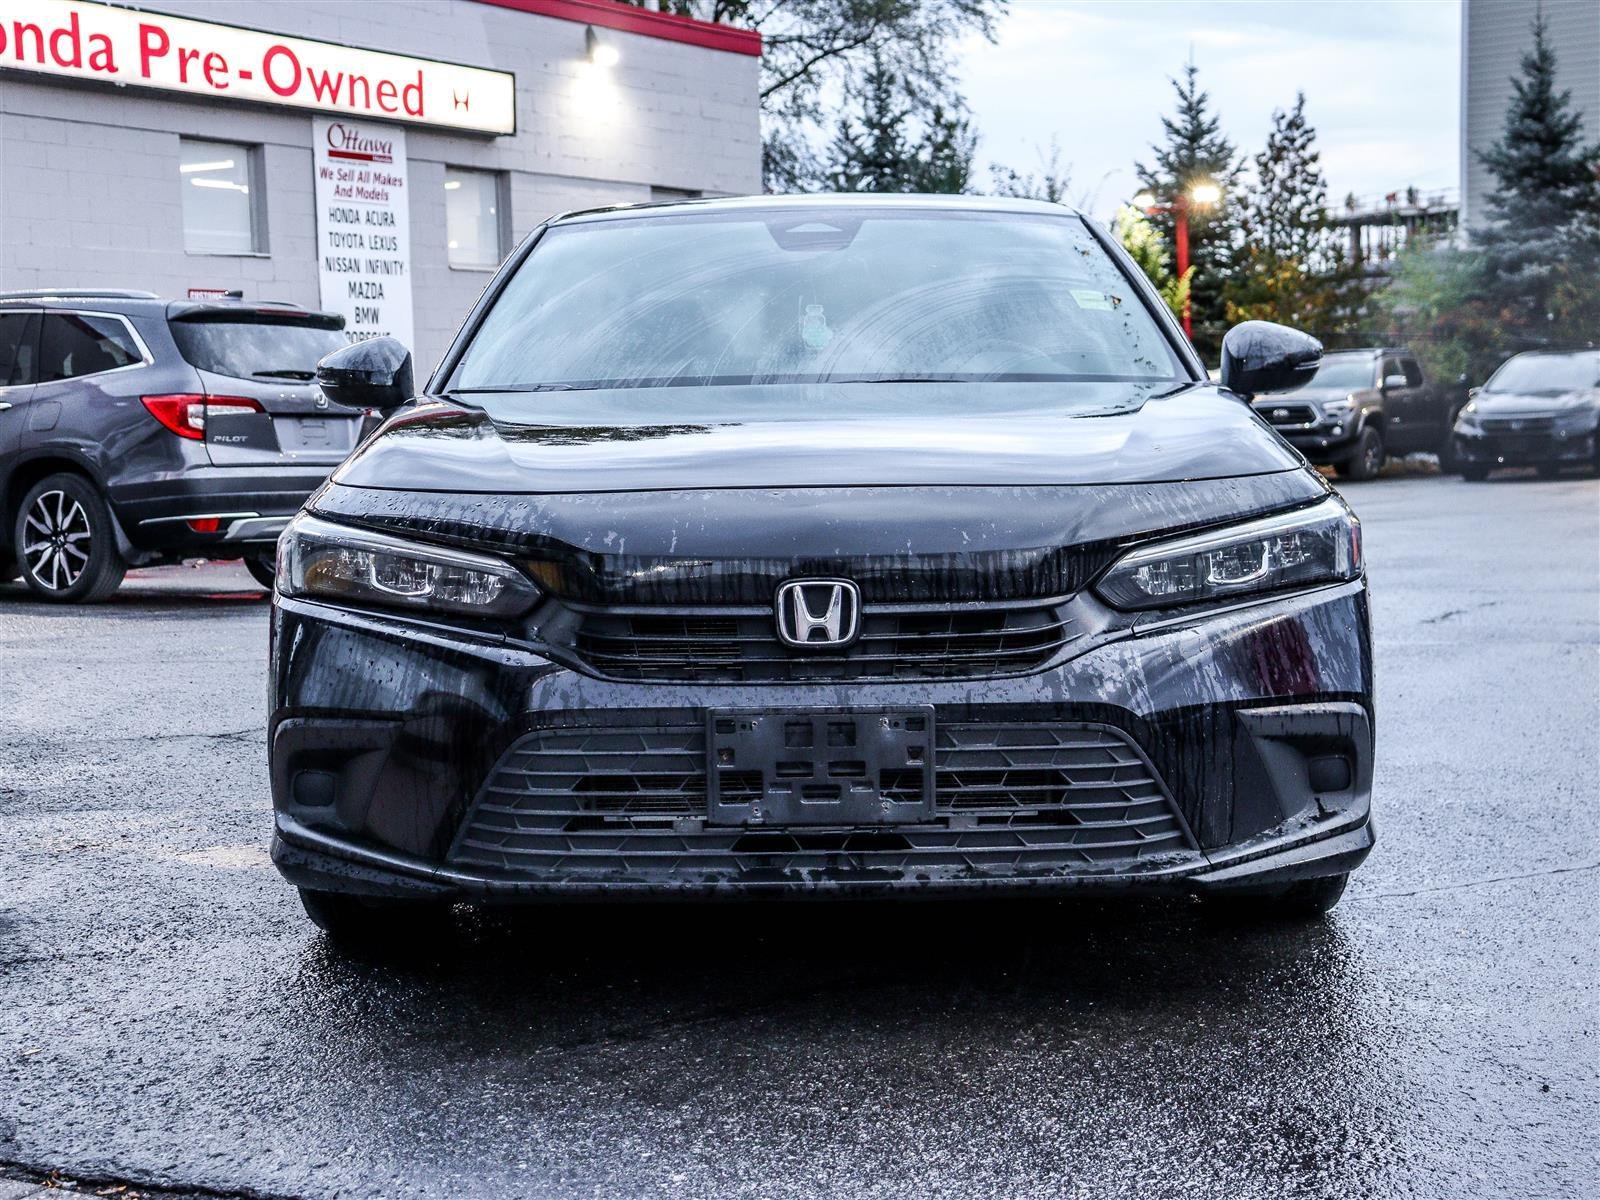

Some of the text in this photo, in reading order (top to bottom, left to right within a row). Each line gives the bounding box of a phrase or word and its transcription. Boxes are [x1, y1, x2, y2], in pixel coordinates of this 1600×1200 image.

[0, 12, 424, 117] nda Pre-Owned
[327, 122, 393, 154] Ottawa
[320, 166, 403, 187] We Sell All Makes
[334, 184, 389, 201] And Models
[328, 207, 396, 227] HONDA ACURA
[328, 231, 398, 252] TOYOTA LEXUS
[325, 256, 404, 275] NISSAN INFINITY
[348, 281, 384, 300] MAZDA
[355, 306, 380, 324] BMW
